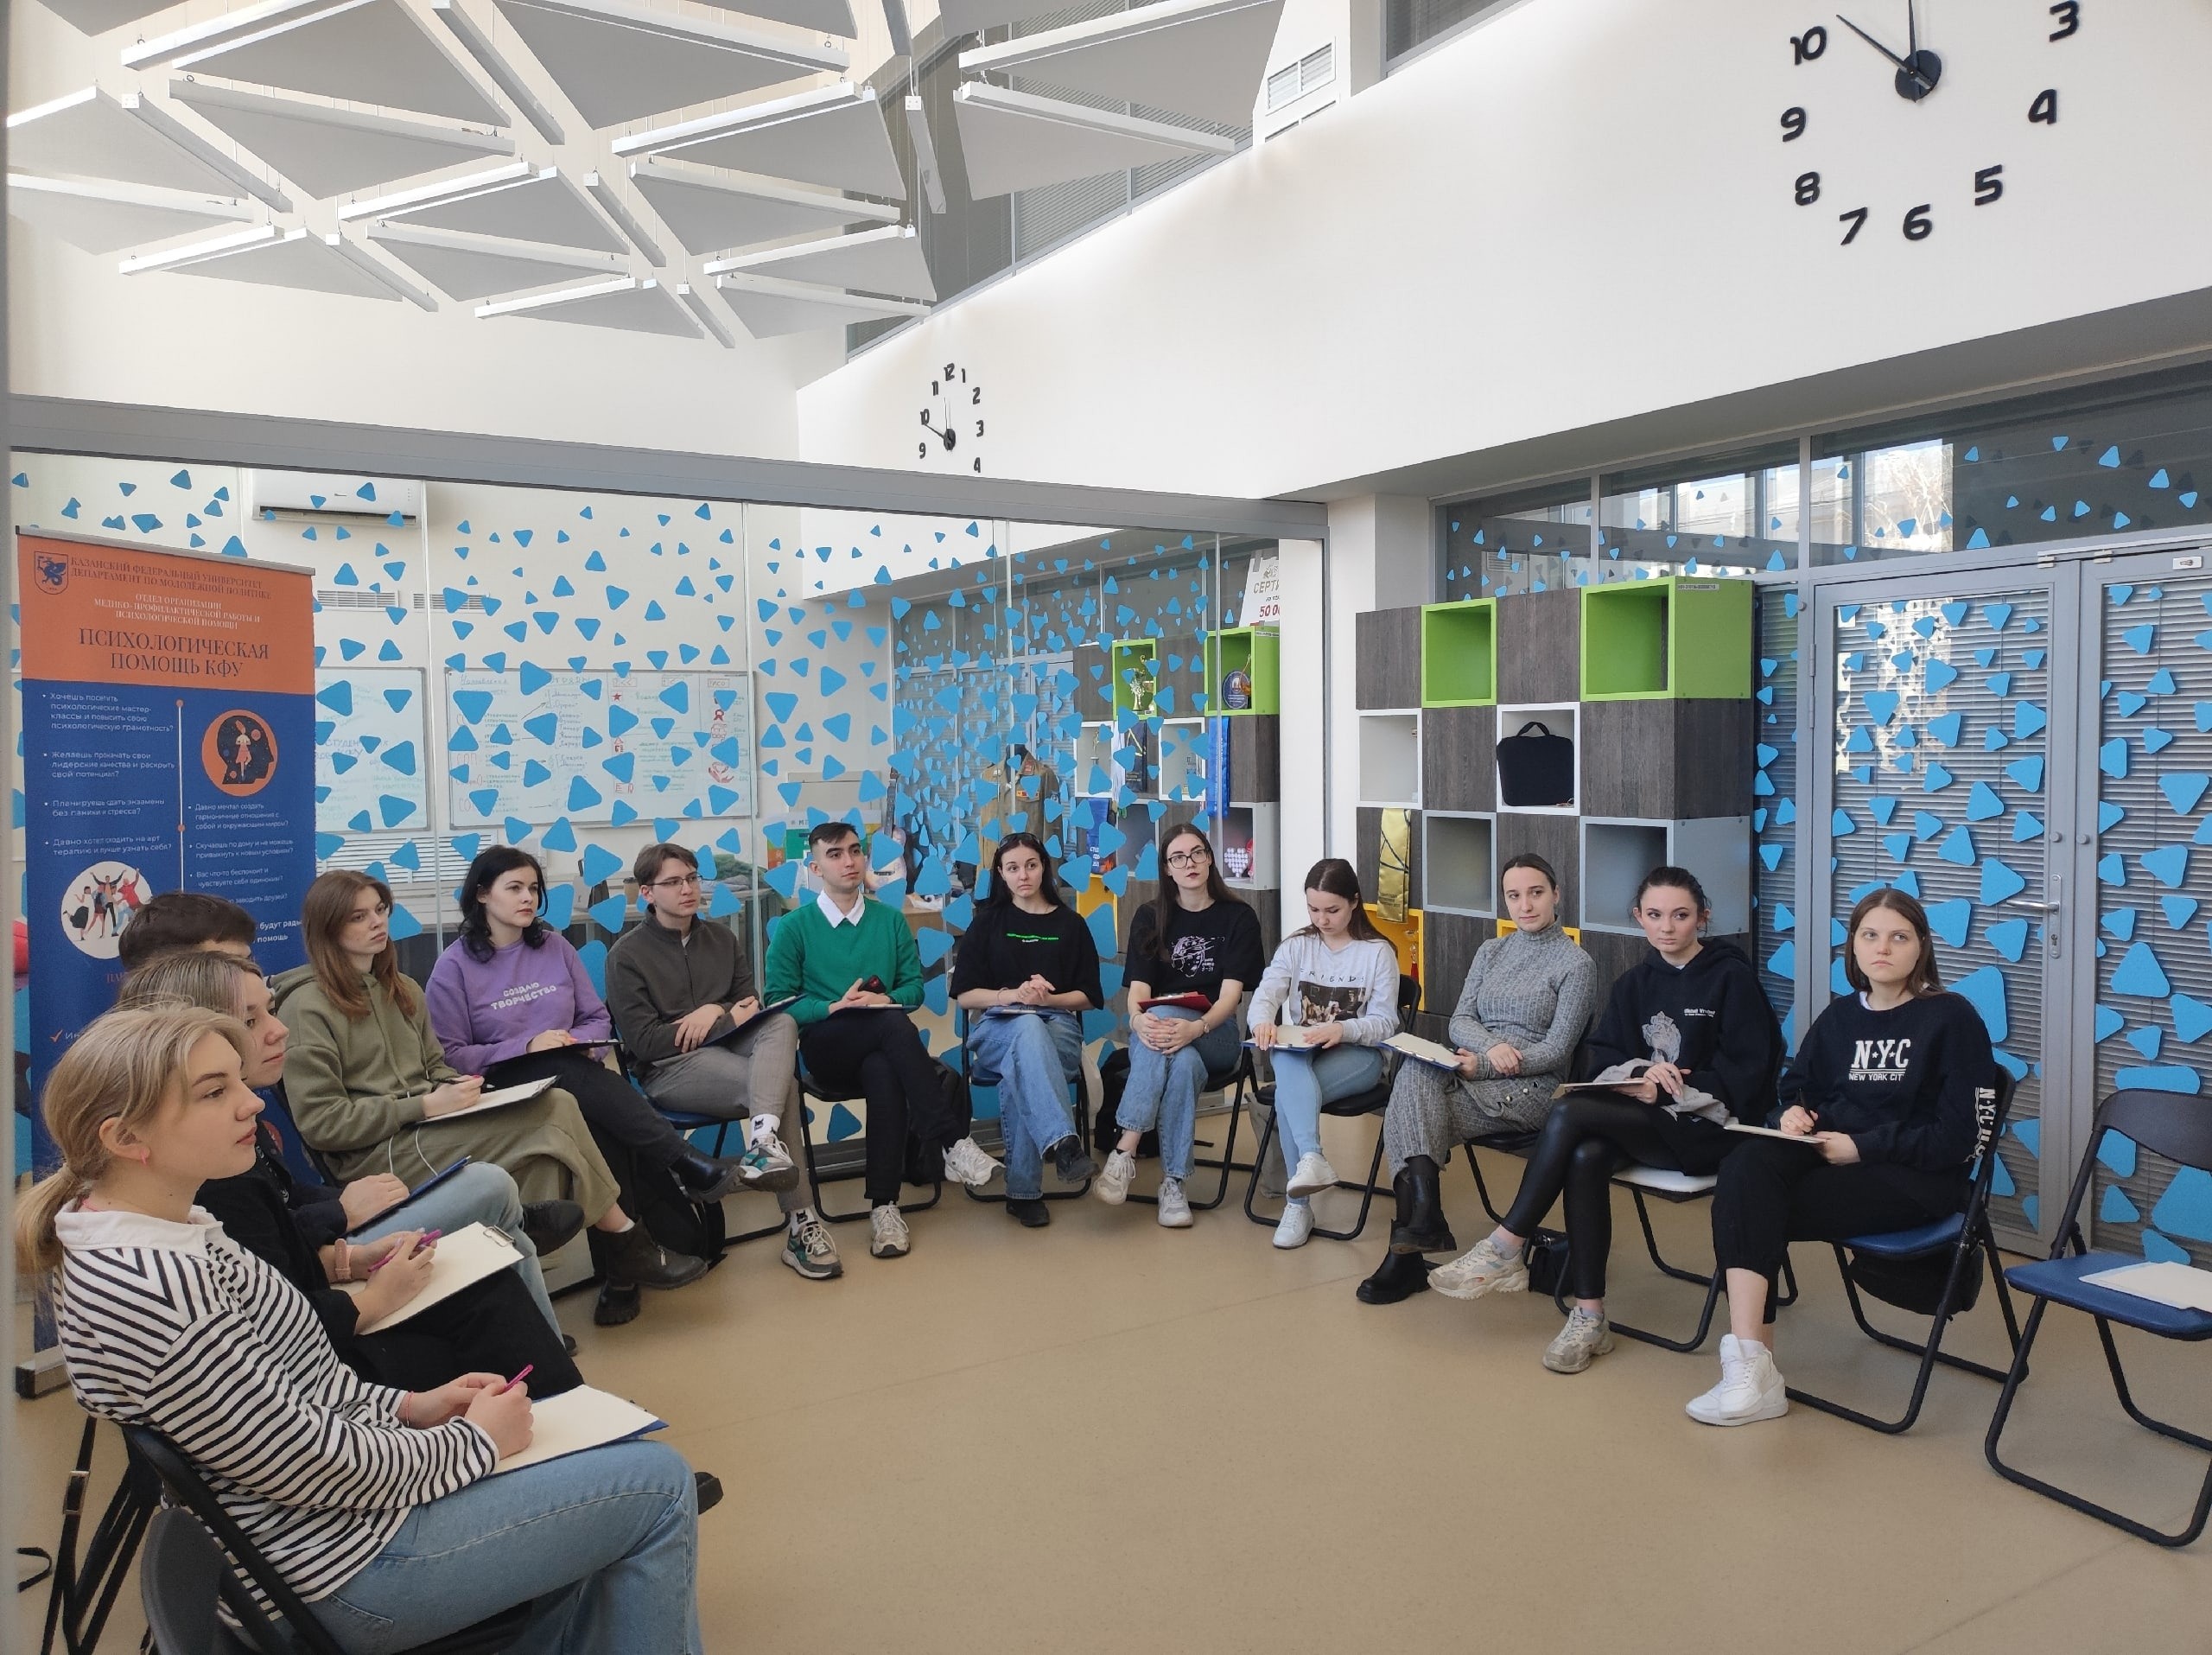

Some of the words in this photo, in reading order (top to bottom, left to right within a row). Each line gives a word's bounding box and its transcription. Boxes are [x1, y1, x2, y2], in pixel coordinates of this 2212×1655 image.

[2050, 0, 2079, 42] 3
[1789, 26, 1827, 65] 10
[2029, 89, 2056, 124] 4
[1781, 106, 1807, 142] 9
[1795, 171, 1821, 206] 8
[1975, 164, 2003, 206] 5
[1840, 207, 1868, 245] 7
[1904, 204, 1933, 240] 6
[944, 363, 955, 381] 12
[962, 368, 966, 383] 1
[932, 380, 939, 396] 11
[973, 387, 981, 404] 2
[920, 409, 930, 425] 10
[976, 420, 984, 437] 3
[919, 442, 926, 459] 9
[974, 457, 981, 473] 4
[71, 557, 130, 572] КАЗАНСКИЙ
[133, 564, 200, 581] ФЕДЕРАЛЬНЫЙ
[202, 574, 263, 589] УНИВЕРСИТЕТ
[71, 567, 140, 583] ДЕПАРТАМЕНТ
[144, 576, 157, 585] ПО
[136, 594, 162, 604] ОТДЕЛ
[164, 596, 222, 610] ОРГАНИЗАЦИИ
[223, 611, 252, 622] РАБОТЫ
[1260, 605, 1271, 618] 50
[1273, 604, 1281, 616] 0
[116, 610, 200, 627] ПСИХОЛОГИЧЕСКОЙ
[201, 617, 238, 629] ПОМОЩИ
[79, 627, 270, 659] ПСИХОЛОГИЧЕСКАЯ
[111, 652, 200, 676] ПОМОЩЬ
[206, 659, 244, 678] КФУ
[49, 692, 84, 701] Хочешь
[51, 703, 119, 712] психологические
[51, 722, 121, 732] психологическую
[122, 723, 174, 733] грамотность?
[51, 761, 99, 770] лидерские
[53, 799, 105, 809] Планируешь
[195, 803, 216, 812] Давно
[53, 838, 82, 847] Давно
[259, 920, 283, 931] будут
[257, 933, 289, 944] помощь
[503, 982, 540, 996] СОЗДАЮ
[491, 985, 556, 1010] ТВОРЧЕСТВО
[1849, 1073, 1866, 1081] NEW
